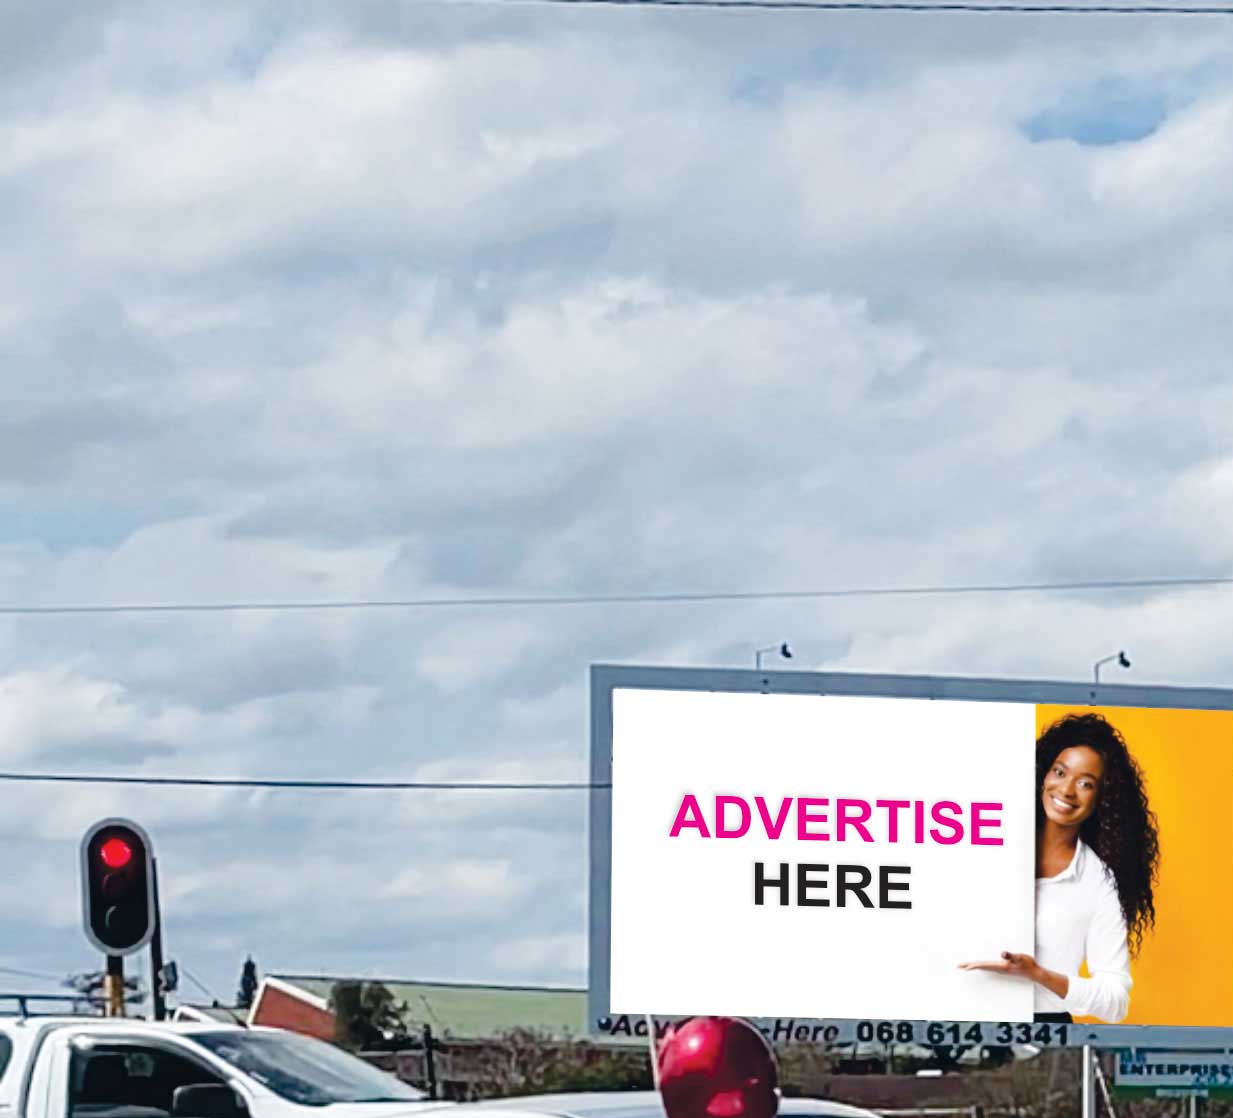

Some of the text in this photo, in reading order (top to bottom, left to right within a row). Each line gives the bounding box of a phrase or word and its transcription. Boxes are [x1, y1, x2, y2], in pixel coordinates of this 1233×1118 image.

[669, 794, 1004, 846] ADVERTISE
[754, 862, 912, 910] HERE
[856, 1021, 913, 1043] 068
[927, 1023, 983, 1044] 614
[996, 1023, 1068, 1046] 3341
